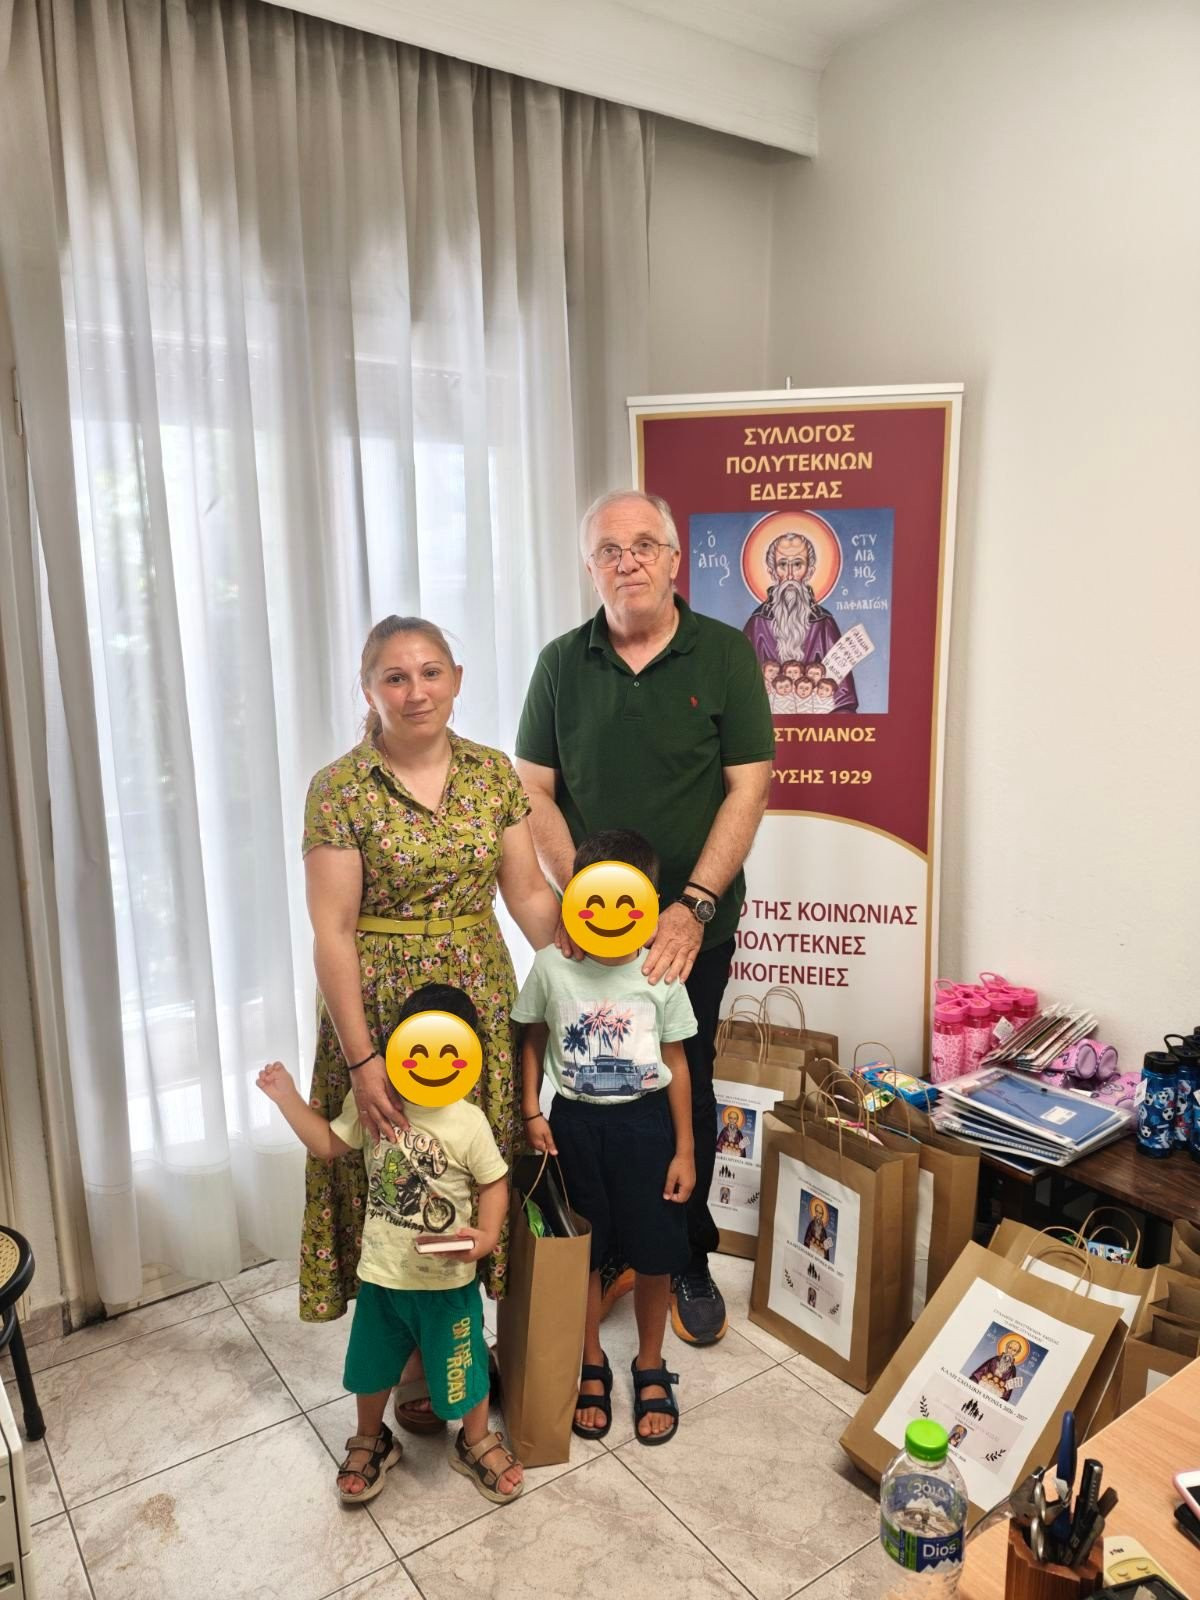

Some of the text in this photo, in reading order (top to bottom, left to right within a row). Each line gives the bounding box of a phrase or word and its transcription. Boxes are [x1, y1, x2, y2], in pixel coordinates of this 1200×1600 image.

[744, 424, 855, 446] ΣΥΛΛΟΓΟΣ
[726, 452, 873, 474] ΠΟΛΥΤΕΚΝΩΝ
[750, 481, 842, 501] ΕΔΕΣΣΑΣ
[773, 727, 876, 742] ΣΤΥΛΙΑΝΟΣ
[770, 769, 872, 785] ΥΣΗΣ 1929
[752, 900, 792, 920] ΤΗΣ
[798, 902, 918, 925] ΚΟΙΝΩΝΙΑΣ
[729, 961, 849, 987] ΙΚΟΓΕΝΕΙΕΣ
[447, 1356, 466, 1405] ROAD
[922, 1543, 956, 1558] Dios
